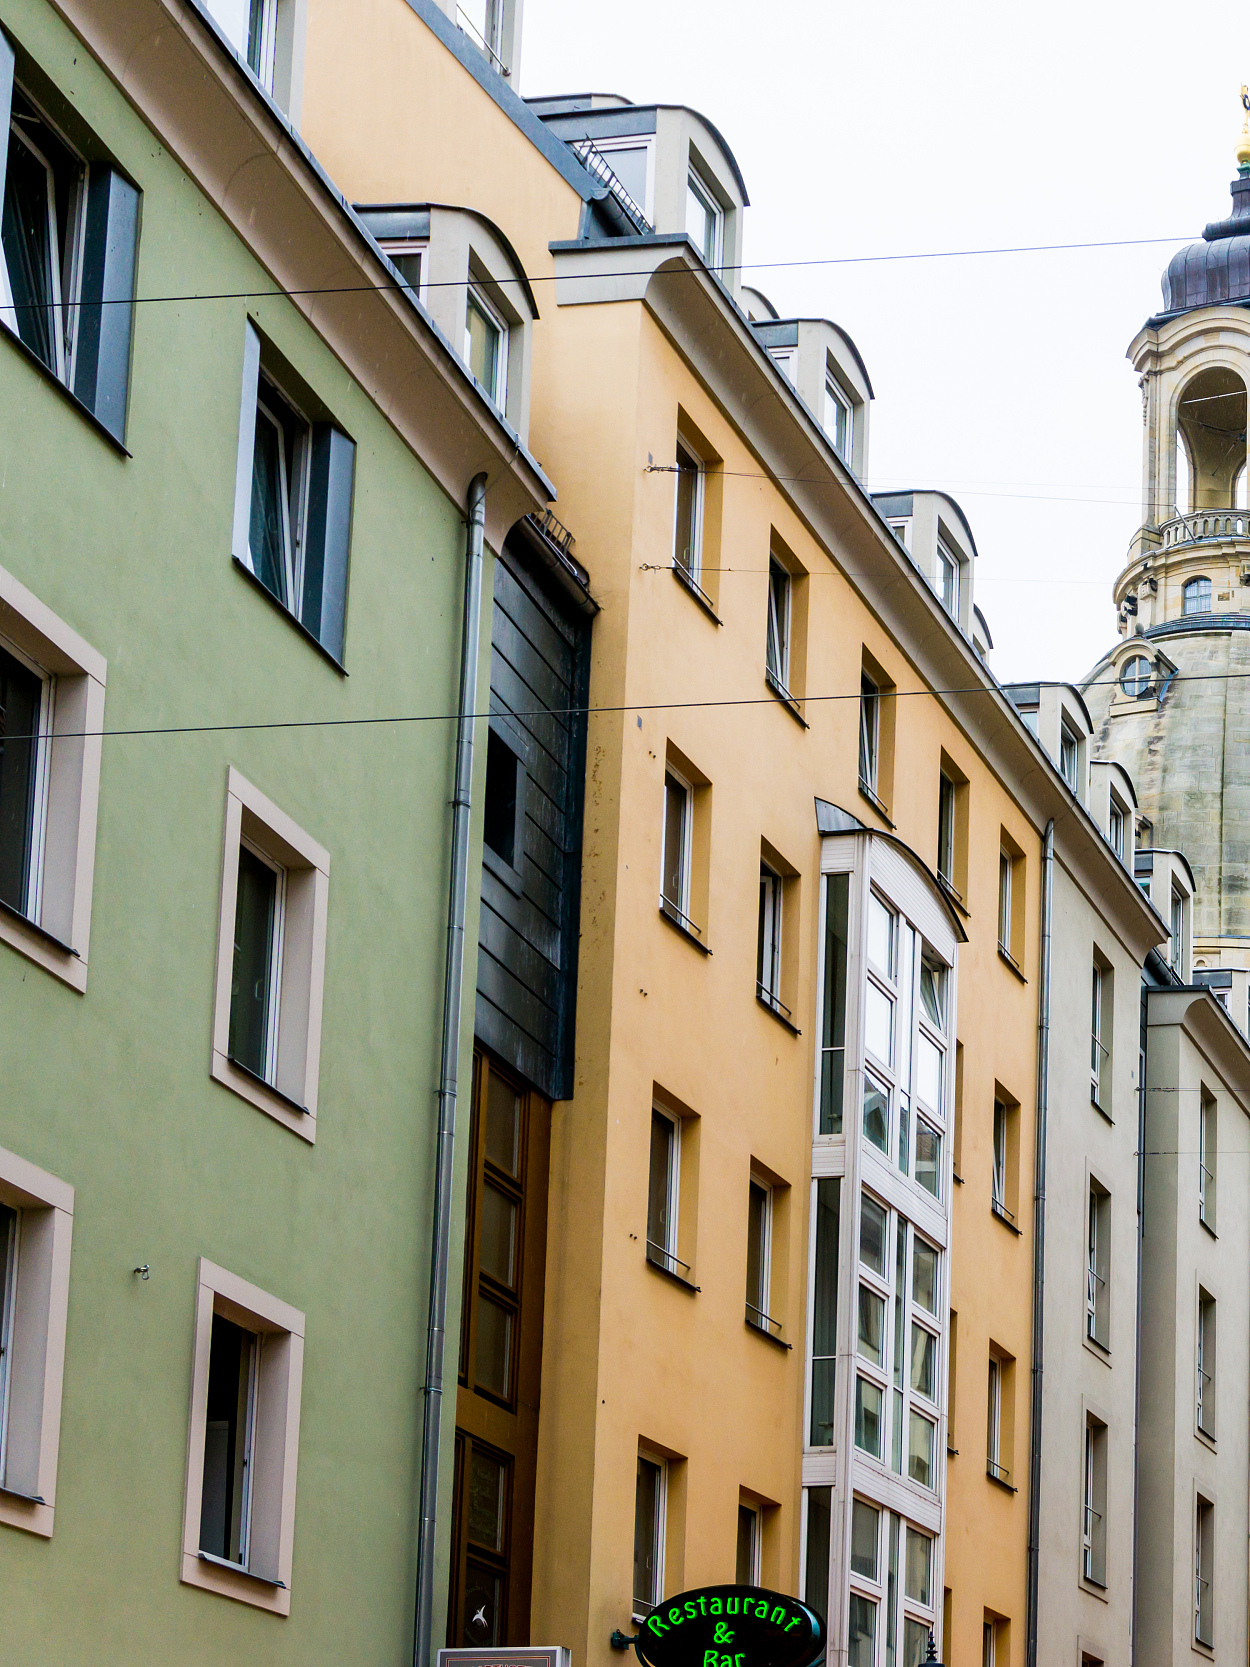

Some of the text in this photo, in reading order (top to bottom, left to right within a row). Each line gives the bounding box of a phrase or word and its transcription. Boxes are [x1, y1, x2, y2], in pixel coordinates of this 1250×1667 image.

[647, 1596, 802, 1637] Restaurant
[713, 1621, 735, 1644] &
[703, 1650, 746, 1667] Bar
